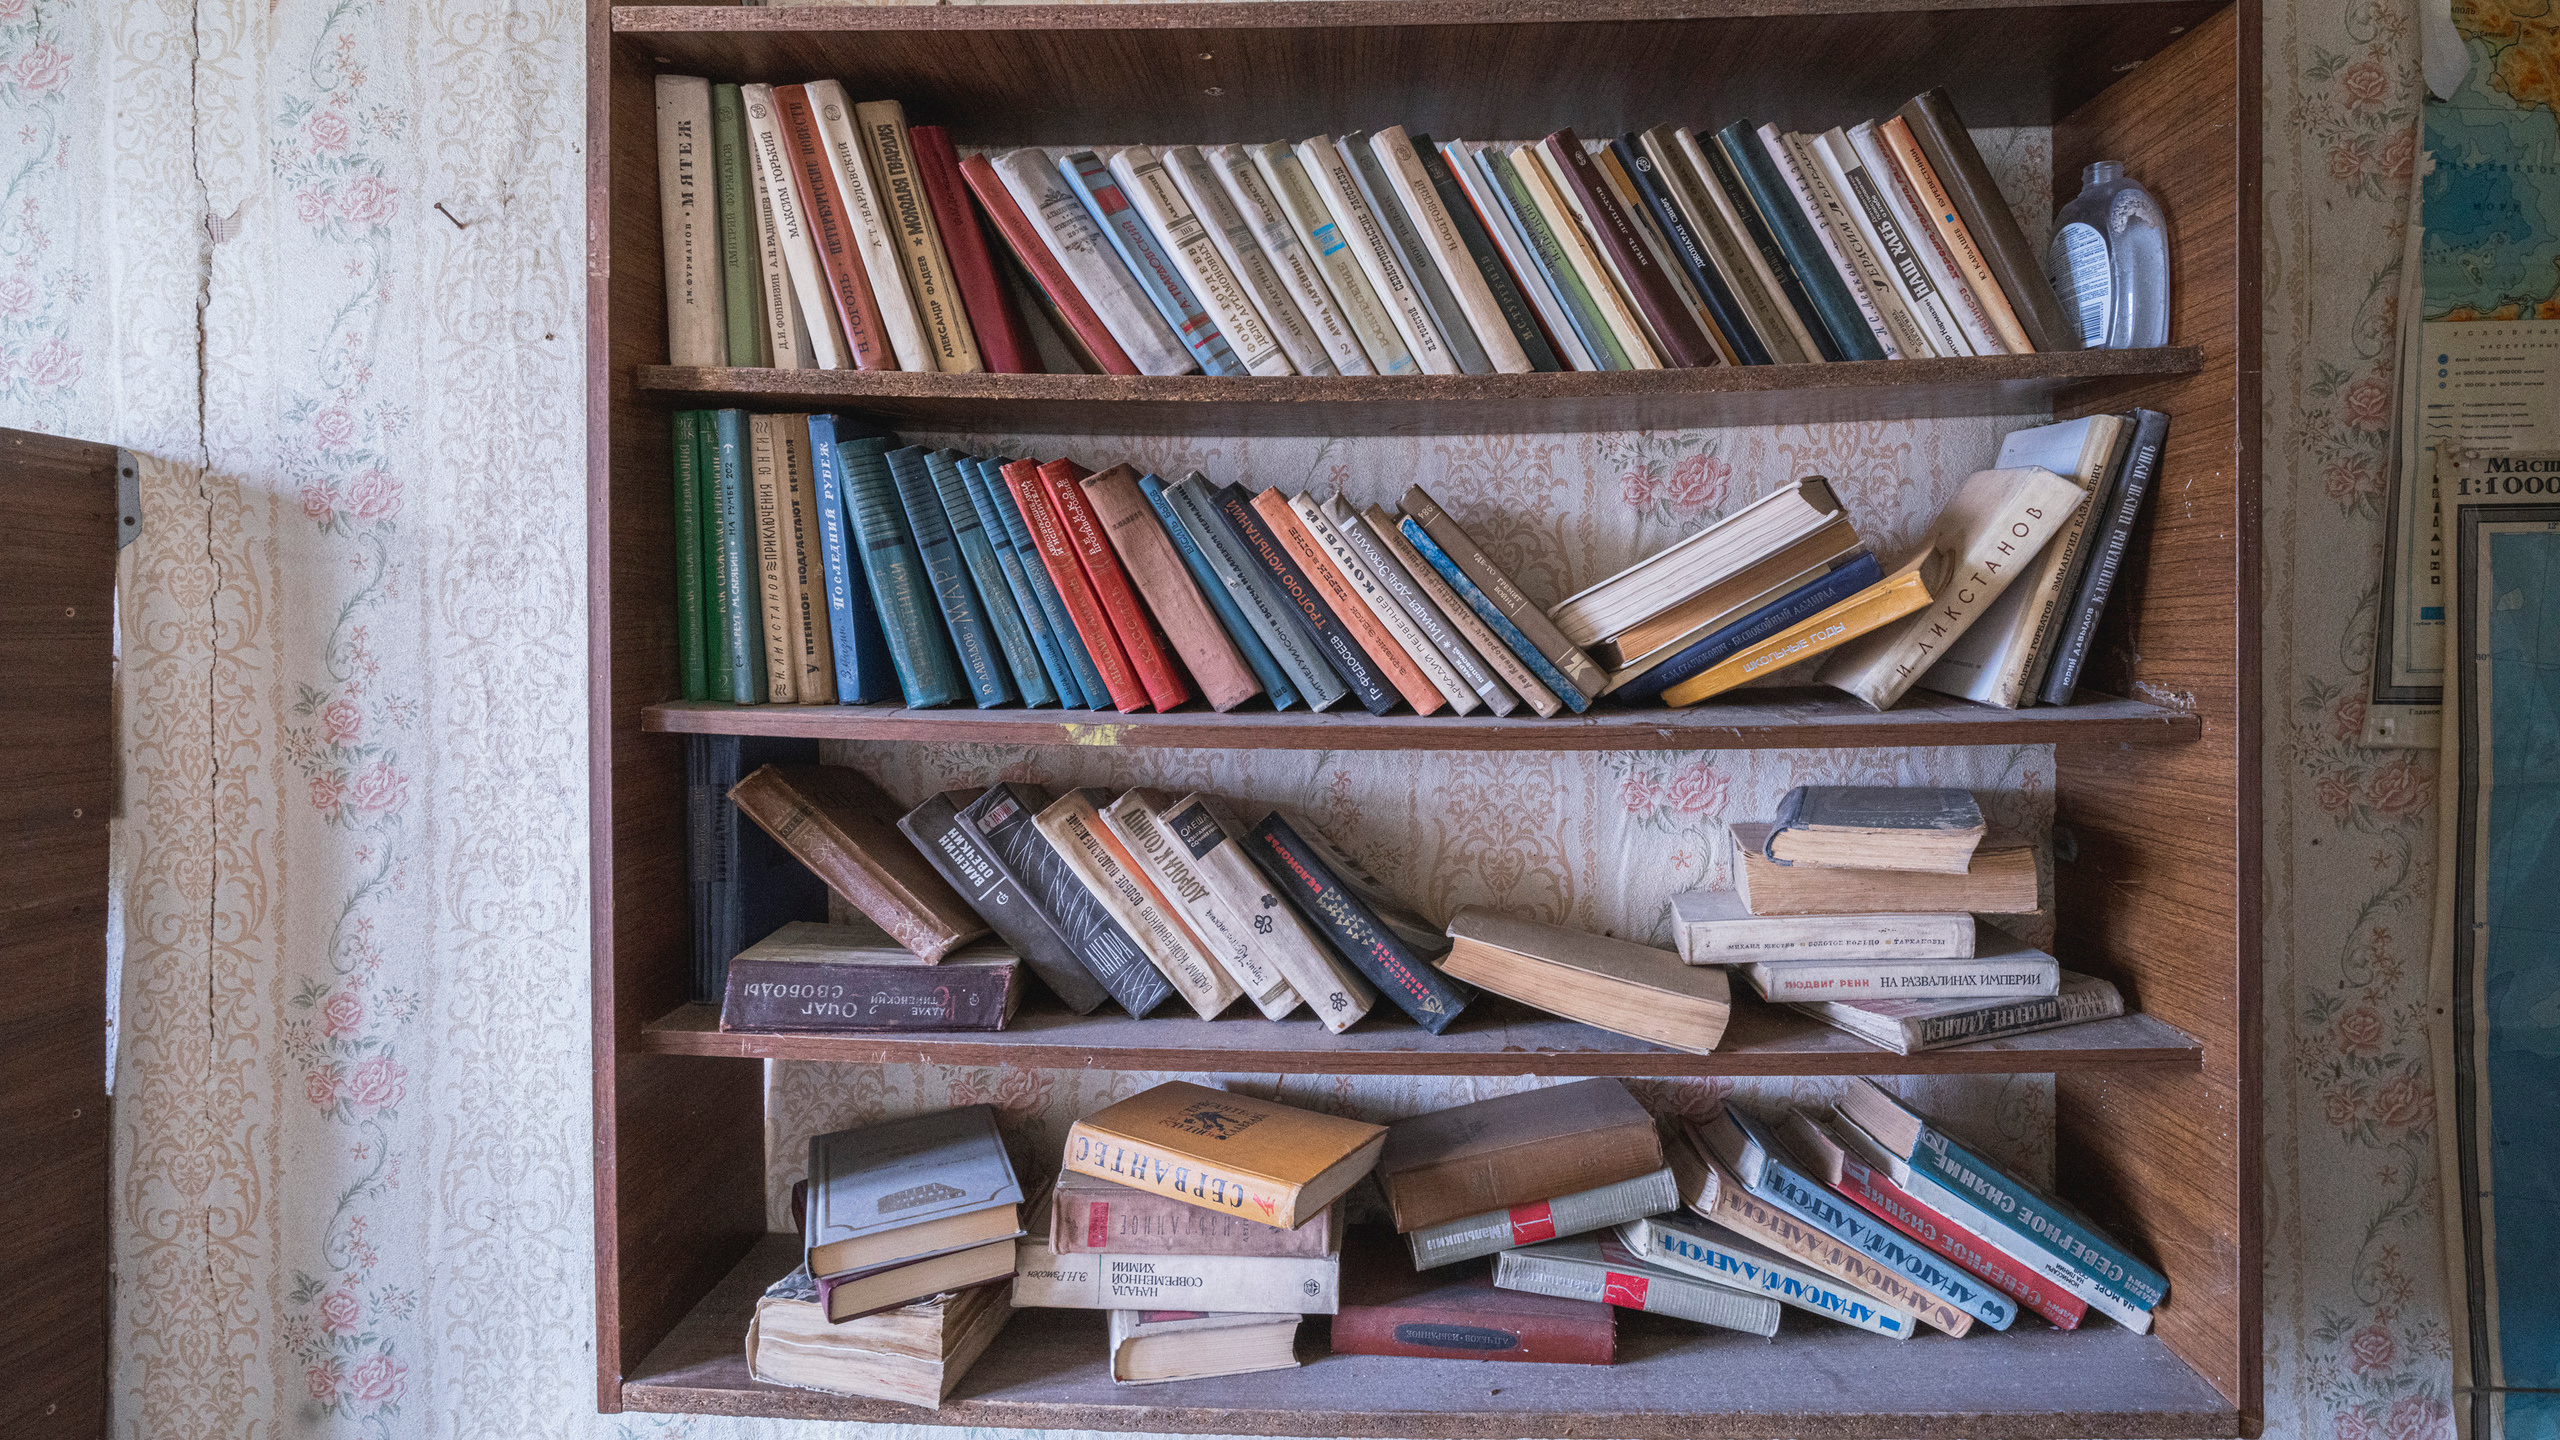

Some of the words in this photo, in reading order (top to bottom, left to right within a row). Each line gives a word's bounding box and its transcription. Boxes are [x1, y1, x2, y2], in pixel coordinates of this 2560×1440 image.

[788, 100, 815, 157] ПОВЕСТИ
[876, 121, 905, 177] ГВАРДИЯ
[678, 119, 694, 207] МЯТЕЖ
[722, 143, 735, 206] ФУРМАНОВ
[759, 129, 784, 184] ГОРЬКИЙ
[1908, 147, 1946, 208] БУРЕВЕСТНИКИ
[777, 186, 799, 239] МАКСИМ
[805, 158, 843, 255] ПЕТЕРБУРГСКИЕ
[892, 175, 923, 237] МОЛОДАЯ
[1332, 165, 1362, 211] РАССКАЗЫ
[1595, 184, 1629, 235] ЛИПАТОВ
[1659, 196, 1679, 223] СВИФТ
[1781, 151, 1829, 229] РАССКАЗЫ
[726, 212, 738, 267] ДМИТРИЙ
[1381, 194, 1410, 236] БАЛЬЗАК
[1877, 218, 1906, 257] ХЛЕБ
[1121, 218, 1182, 299] ТВАРДОВСКИЙ
[1356, 212, 1405, 292] СЕВАСТОПОЛЬСКИЕ
[1405, 236, 1428, 268] ОНОРЕ
[1627, 236, 1648, 266] ВИЛЬ
[1674, 223, 1706, 268] ДЖОНАТАН
[1838, 219, 1890, 296] ГЕРАСИМ
[1953, 227, 1981, 269] КАРДАШЕВ
[917, 254, 936, 295] ФАДЕЕВ
[1187, 245, 1232, 311] ГОРДЕЕВ
[1196, 240, 1249, 318] АРТАМОНОВЫХ
[1247, 253, 1285, 307] КАРЕНИНА
[1287, 253, 1323, 307] КАРЕНИНА
[1898, 256, 1929, 297] НАШ
[768, 273, 789, 350] Д.И.ФОНВИЗИН
[930, 298, 955, 359] АЛЕКСАНДР
[1281, 308, 1303, 338] АННА
[1319, 307, 1342, 338] АННА
[1335, 260, 1391, 348] ВОСКРЕСЕНИЕ
[1227, 313, 1257, 354] ФОМА
[1244, 317, 1268, 348] ДЕЛО
[2453, 328, 2559, 337] УСЛОВНЫЕ
[680, 444, 692, 511] РЕВОЛЮЦИЯ
[725, 462, 734, 479] 202
[755, 436, 771, 475] ЮНГИ
[785, 438, 798, 492] КРЫЛЬЯ
[817, 441, 833, 501] РУБЕЖ
[726, 484, 736, 515] РУМБЕ
[1018, 481, 1034, 503] ЛИЦА
[1023, 479, 1061, 546] ИСПОЛНИТЕЛИ
[1061, 477, 1102, 554] ПРОТИВОСТОЯНИЕ
[1148, 487, 1172, 519] БЫКОВ
[1174, 483, 1213, 535] МЕРИДИАНЕ
[728, 520, 737, 535] НА
[759, 483, 778, 560] ПРИКЛЮЧЕНИЯ
[790, 498, 809, 584] ПОДРАСТАЮТ
[1027, 501, 1060, 558] ДЕЙСТВУЮЩИЕ
[1168, 520, 1194, 555] ВАСИЛЬ
[1222, 499, 1287, 576] ИСПЫТАНИЙ
[1287, 525, 1315, 558] ОГНЕ
[714, 518, 726, 585] СРАЖАЛАСЬ
[1209, 533, 1241, 575] ДАЛЕКОМ
[1302, 508, 1377, 594] КОЧУБЕЙ
[1348, 527, 1391, 577] ЭСКУЛАПА
[2017, 652, 2035, 687] БОРИС
[2029, 599, 2054, 651] ГОРБАТОВ
[2050, 530, 2079, 592] ЭММАНУИЛ
[2073, 462, 2103, 528] КАЗАКЕВИЧ
[2059, 657, 2077, 686] ЮРИЙ
[2072, 606, 2096, 656] ДАВЫДОВ
[2089, 527, 2128, 605] КАПИТАНЫ
[2116, 482, 2143, 525] ИЩУТ
[2132, 443, 2156, 479] ПУТЬ
[685, 590, 695, 611] КАК
[718, 590, 727, 612] КАК
[928, 554, 973, 628] МАРТ
[1022, 556, 1068, 635] ВСЕРОССИЙСКИЙ
[1236, 572, 1249, 586] НА
[1244, 583, 1272, 619] ВСТРЕЧА
[1280, 573, 1328, 629] ТРОПОЮ
[1316, 563, 1348, 602] ТЕРЕК
[1472, 552, 1496, 576] ГДЕ-ТО
[1496, 576, 1523, 603] ГРЕМИТ
[1493, 585, 1516, 609] ВОЙНА
[1913, 503, 2045, 656] ЛИКСТАНОВ
[766, 572, 784, 665] ЛИКСТАНОВ
[800, 592, 815, 654] ПТЕНЦОВ
[1374, 593, 1426, 653] ПЕРВЕНЦЕВ
[1730, 607, 1792, 647] БЕСПОКОЙНЫЙ
[1791, 585, 1836, 615] АДМИРАЛ
[806, 662, 819, 673] У
[962, 631, 988, 682] ДАВЫДОВ
[1043, 641, 1065, 677] МОРОЗОВА
[1065, 635, 1091, 676] МОРОЗОВА
[1274, 626, 1304, 666] УИЛСОН
[1454, 658, 1472, 678] МАРК
[1473, 626, 1519, 675] Канторович
[1742, 636, 1808, 674] ШКОЛЬНЫЕ
[1809, 620, 1845, 644] ГОДЫ
[718, 675, 728, 690] 2
[1059, 676, 1074, 696] ВЕРА
[1084, 675, 1100, 696] ВЕРА
[1300, 663, 1330, 702] МИТЧЕЛ
[1422, 652, 1465, 701] АРКАДИЙ
[1515, 673, 1532, 690] Лев
[1064, 811, 1121, 878] ПОДРАЗДЕЛЕНИЕ
[1120, 803, 1169, 855] СОЛНЦУ
[1179, 811, 1210, 838] ОЛЕША
[937, 833, 983, 889] ВАЛЕНТИН
[947, 824, 994, 881] ОВЕЧКИН
[1153, 846, 1174, 864] К
[1263, 830, 1323, 895] БЕЛОМОРЬЕ
[1114, 873, 1144, 907] ОСОБОЕ
[1160, 854, 1210, 907] ДОРОГА
[1139, 905, 1190, 965] КОЖЕВНИКОВ
[744, 984, 843, 1000] СВОБОДЫ
[1183, 961, 1213, 994] ВАДИМ
[1369, 947, 1423, 1001] АЛЕКСАНДР
[1785, 979, 1833, 990] ЛЮДВИГ
[1840, 978, 1870, 988] РЕНН
[1880, 977, 1899, 988] НА
[1901, 975, 1978, 988] РАЗВАЛИНАХ
[1980, 972, 2042, 986] ИМПЕРИИ
[803, 1002, 858, 1019] ОЧАГ
[1921, 1011, 1990, 1045] ДАЛЬНЕМ
[1991, 1002, 2039, 1030] СЕВЕРЕ
[2036, 998, 2058, 1019] НА
[1076, 1136, 1244, 1208] СЕРВАНТЕС
[1930, 1148, 2018, 1215] СИЯНИЕ
[1717, 1188, 1823, 1257] АЛЕКСИН
[1761, 1167, 1866, 1241] АЛЕКСИН
[1855, 1180, 1940, 1241] СИЯНИЕ
[1112, 1261, 1156, 1273] ХИМИИ
[1653, 1230, 1760, 1282] АЛЕКСИН
[1859, 1227, 1978, 1309] АНАТОЛИЙ
[2015, 1201, 2125, 1284] СЕВЕРНОЕ
[1112, 1273, 1203, 1288] СОВРЕМЕННОЙ
[1113, 1286, 1158, 1297] НАЧАЛА
[1819, 1243, 1936, 1318] АНАТОЛИЙ
[1935, 1231, 2044, 1307] СЕВЕРНОЕ
[2092, 1281, 2122, 1303] МОРЕ
[1758, 1268, 1876, 1326] АНАТОЛИЙ
[1931, 1304, 1960, 1331] 2
[1977, 1297, 2007, 1326] 3
[2120, 1298, 2136, 1312] НА
